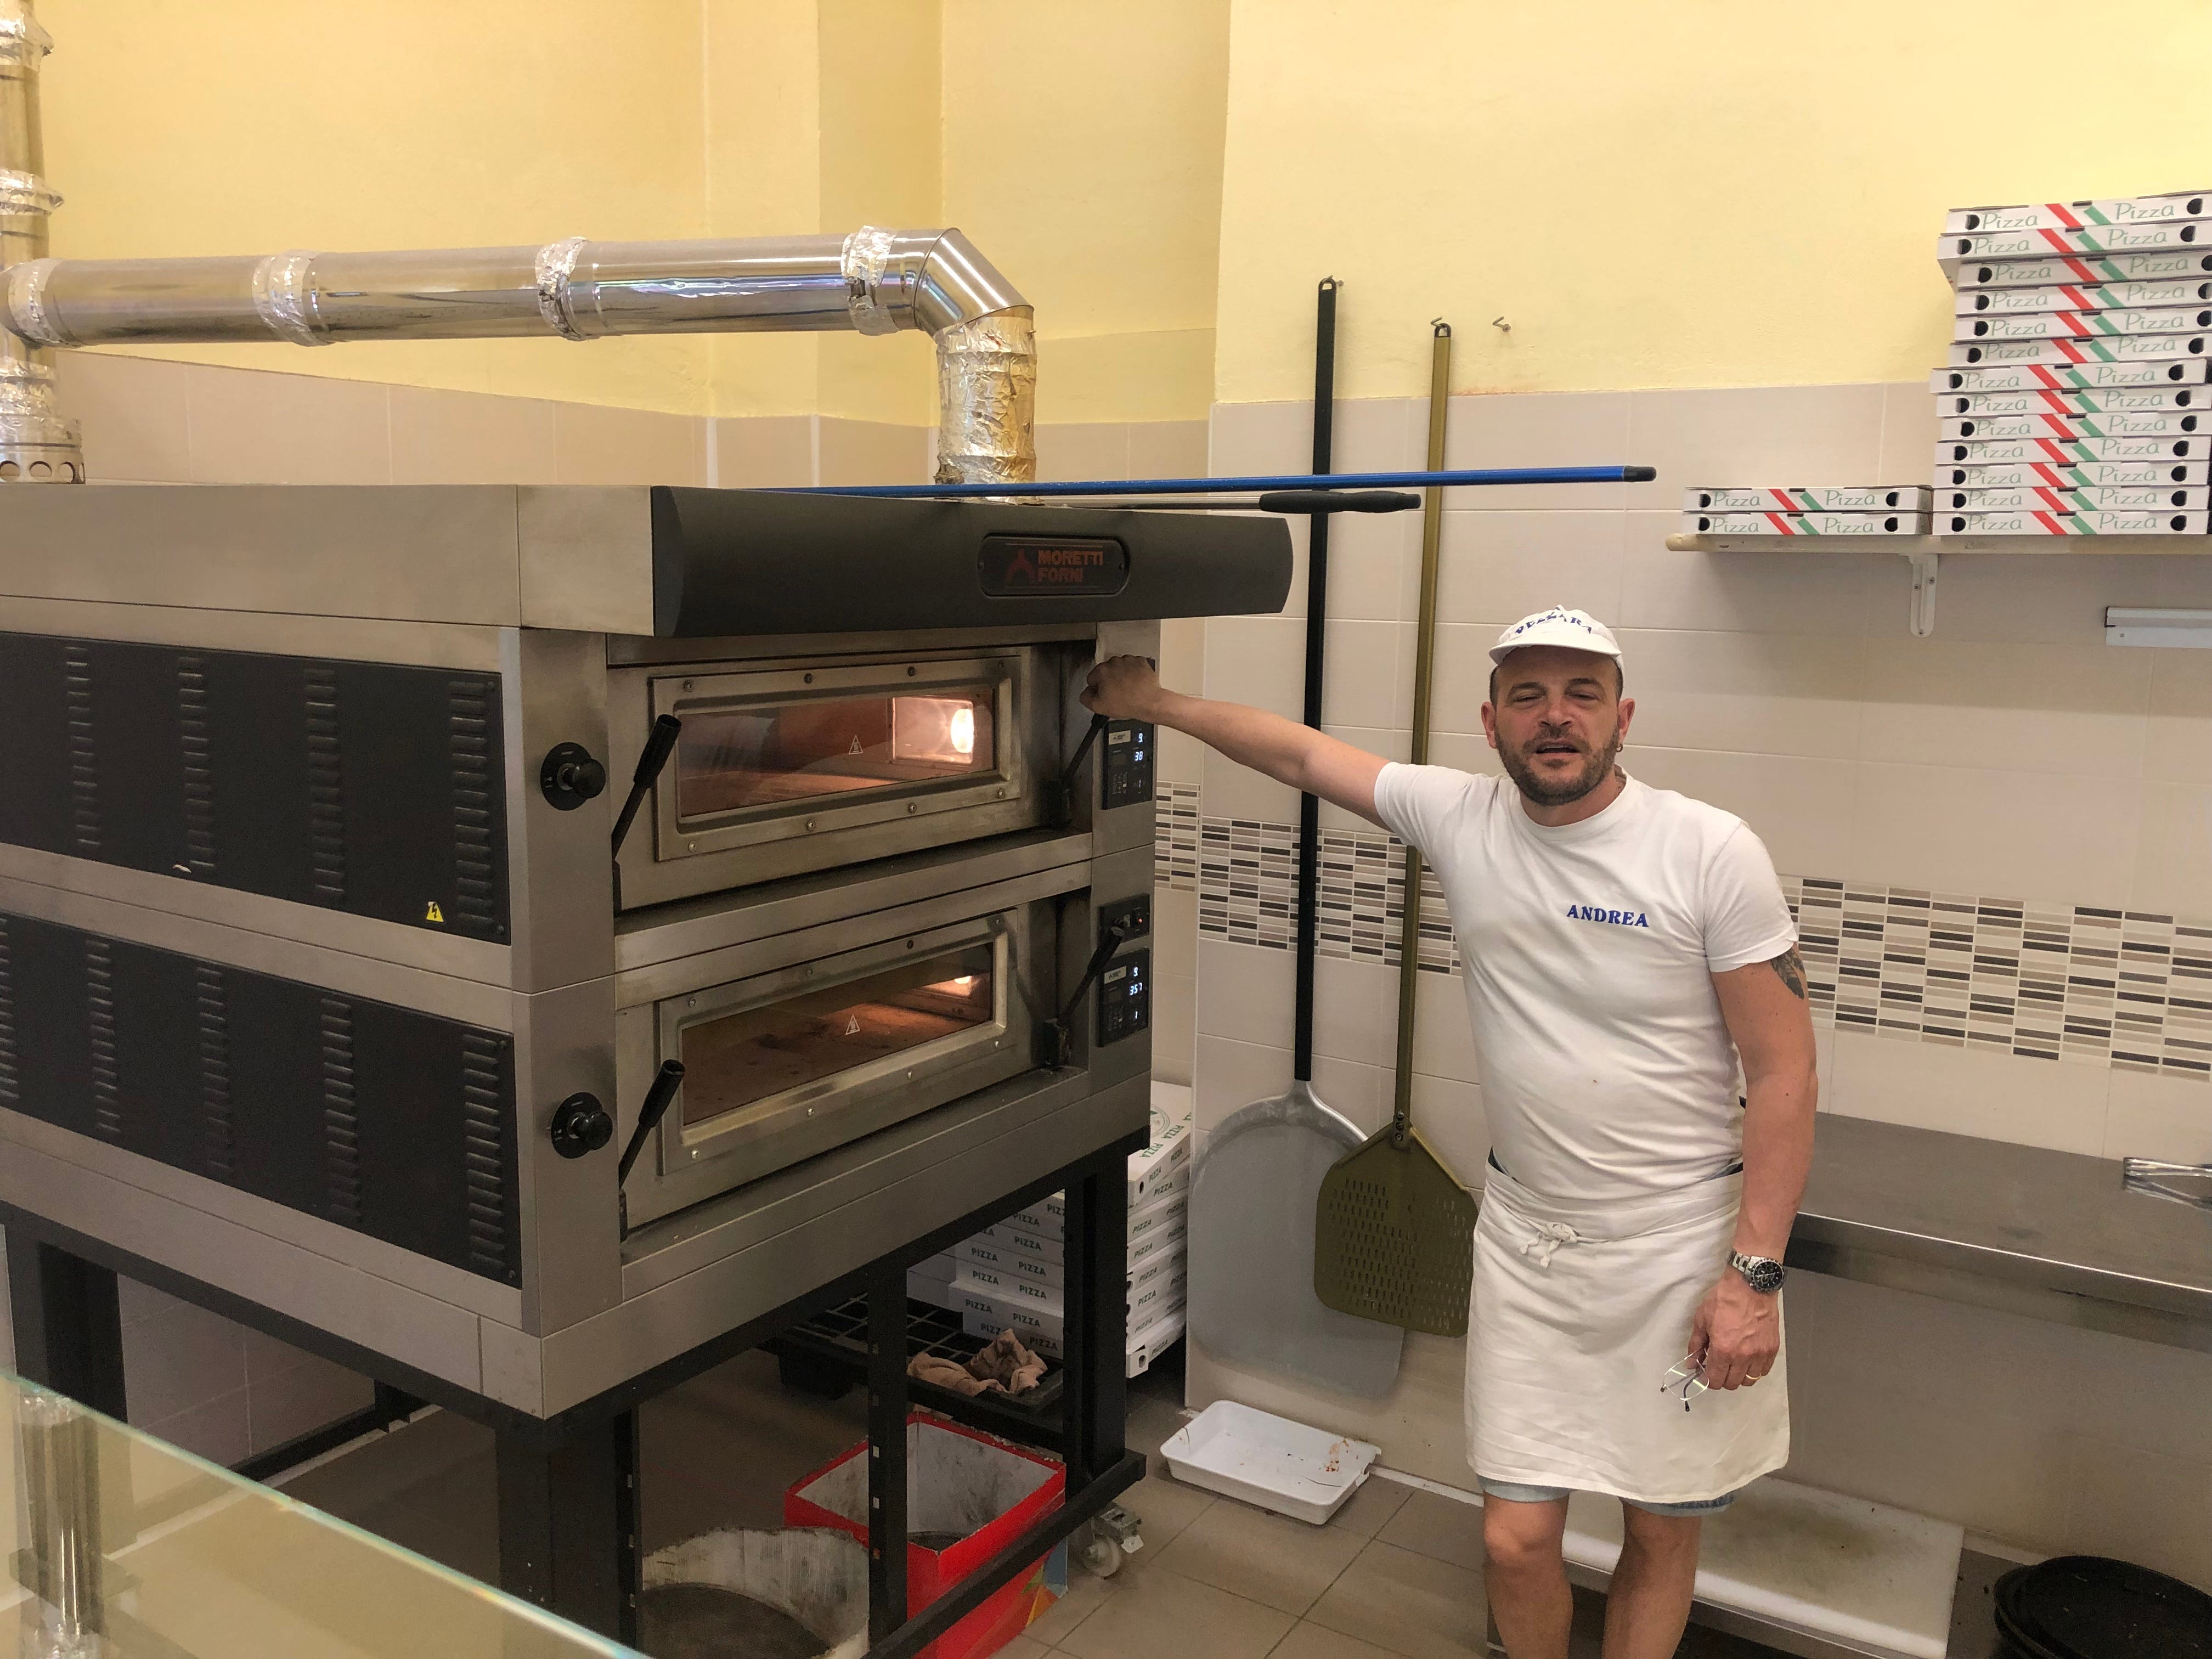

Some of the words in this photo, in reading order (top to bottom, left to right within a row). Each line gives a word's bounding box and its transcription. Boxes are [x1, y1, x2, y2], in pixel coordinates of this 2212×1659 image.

[1982, 213, 2038, 230] Pizza
[2115, 203, 2174, 220] Pizza
[1974, 238, 2030, 254] Pizza
[2108, 229, 2167, 246] Pizza
[1995, 263, 2051, 280] Pizza
[2130, 256, 2188, 273] Pizza
[1992, 292, 2048, 308] Pizza
[2126, 285, 2185, 301] Pizza
[1991, 320, 2047, 336] Pizza
[2125, 313, 2184, 330] Pizza
[1985, 342, 2040, 359] Pizza
[2118, 336, 2175, 353] Pizza
[1965, 372, 2020, 388] Pizza
[2096, 368, 2155, 383] Pizza
[1972, 396, 2028, 412] Pizza
[2104, 391, 2163, 408] Pizza
[1976, 420, 2030, 436] Pizza
[2109, 415, 2166, 432] Pizza
[1970, 443, 2024, 459] Pizza
[2101, 439, 2159, 455] Pizza
[1967, 468, 2022, 484] Pizza
[2098, 465, 2157, 482] Pizza
[1712, 492, 1760, 507] Pizza
[1825, 490, 1876, 506] Pizza
[1967, 489, 2022, 506] Pizza
[2100, 488, 2157, 505] Pizza
[1711, 517, 1759, 533] Pizza
[1824, 517, 1874, 533] Pizza
[1968, 515, 2022, 531] Pizza
[2099, 512, 2157, 529] Pizza
[1038, 550, 1103, 566] MORETTI
[1038, 568, 1083, 582] FORNI
[1567, 905, 1649, 927] ANDREA
[1161, 1125, 1185, 1138] PIZZA
[1139, 1143, 1164, 1157] PIZZA
[1149, 1166, 1161, 1183] PIZZA
[1154, 1182, 1172, 1197] PIZZA
[1047, 1204, 1065, 1215] PIZZ
[1133, 1219, 1152, 1234] PIZZA
[1015, 1237, 1041, 1251] PIZZA
[1134, 1243, 1152, 1259] PIZZA
[972, 1248, 998, 1261] PIZZA
[1019, 1262, 1046, 1276] PIZZA
[1139, 1267, 1157, 1282] PIZZA
[973, 1271, 998, 1285] PIZZA
[1019, 1285, 1047, 1299] PIZZA
[1138, 1290, 1156, 1306] PIZZA
[966, 1299, 992, 1313] PIZZA
[1013, 1313, 1040, 1327] PIZZA
[1135, 1317, 1152, 1333] PIZZA
[981, 1323, 1001, 1334] PIZZ
[1030, 1337, 1058, 1351] PIZZA
[1152, 1339, 1167, 1356] PIZZA
